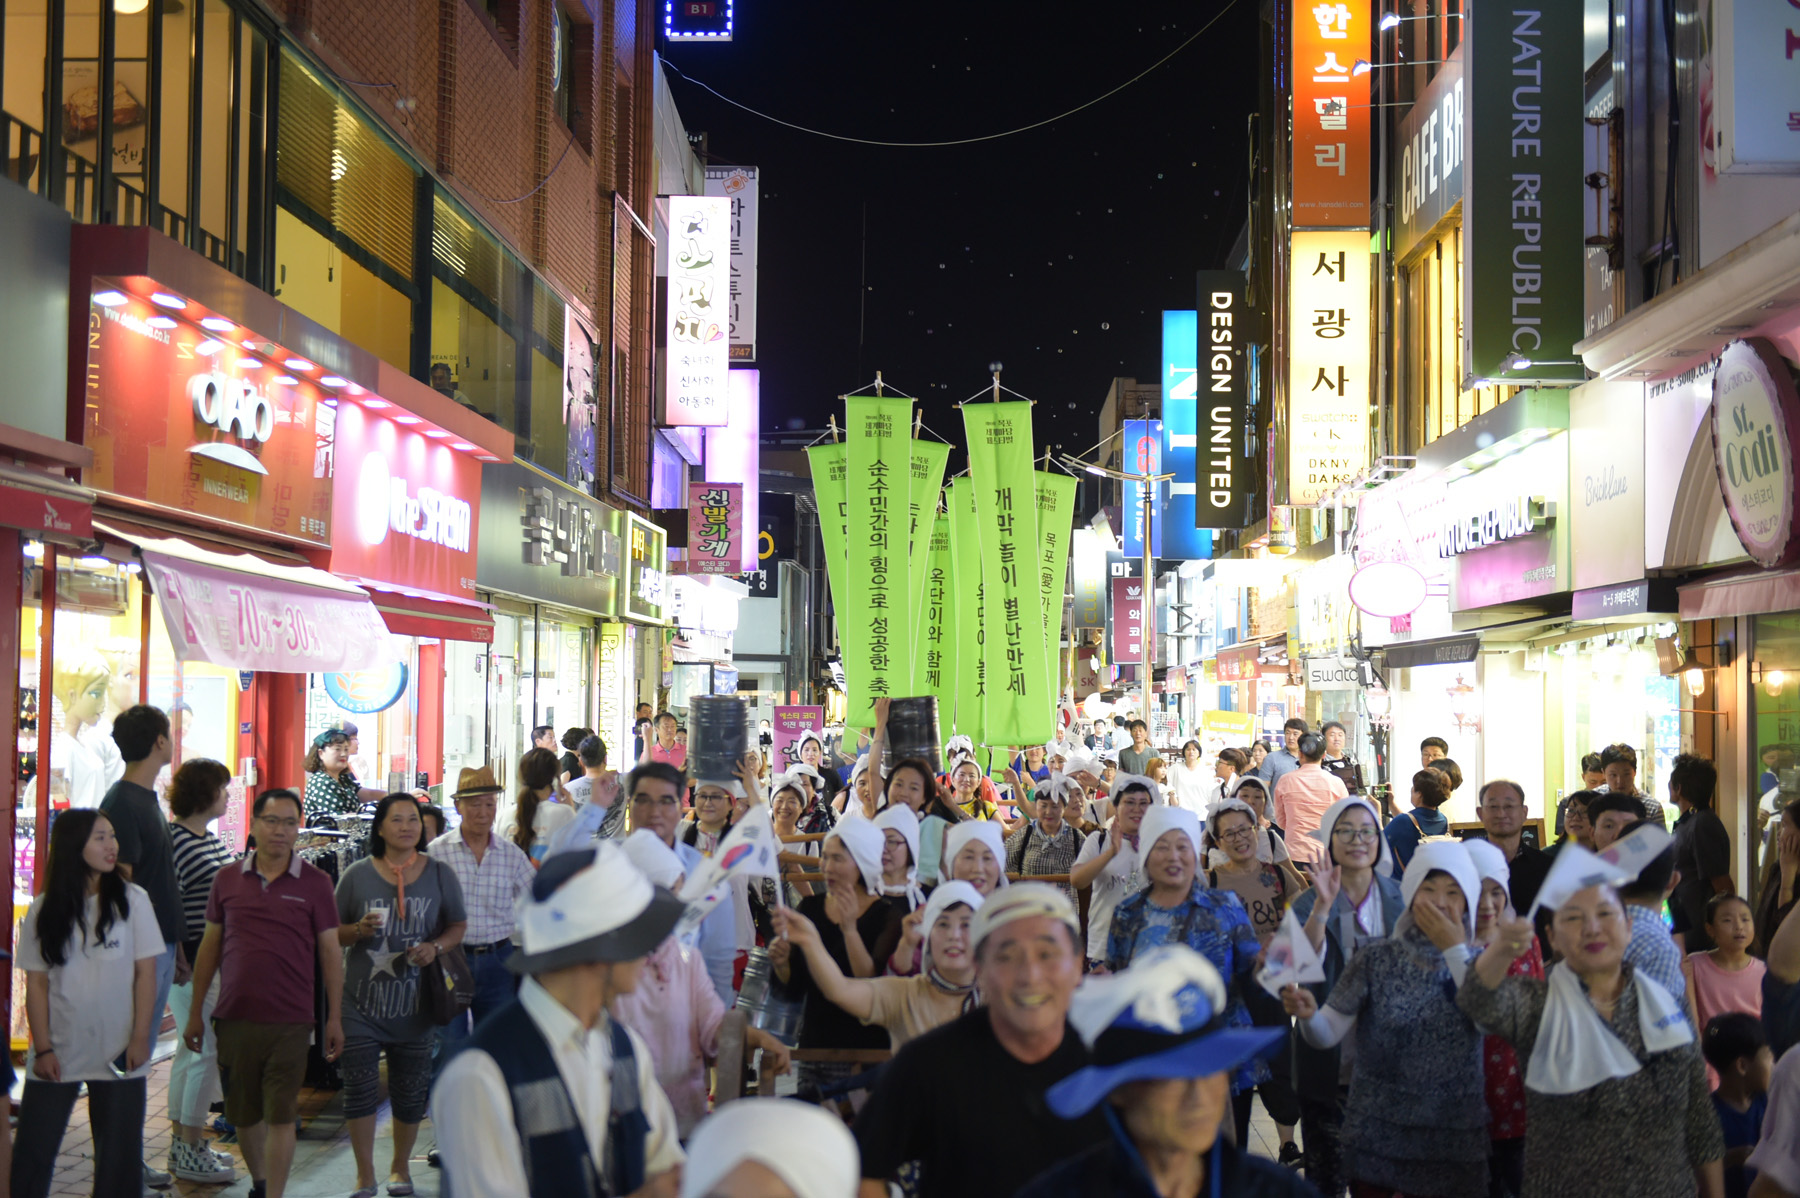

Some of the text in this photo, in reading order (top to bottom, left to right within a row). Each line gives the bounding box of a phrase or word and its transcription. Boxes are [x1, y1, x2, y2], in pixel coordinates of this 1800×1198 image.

[691, 5, 707, 14] B1
[1312, 4, 1351, 176] 한스델리
[1402, 109, 1438, 224] CAFE
[1512, 11, 1541, 351] NATURE REPUBLIC
[1312, 251, 1351, 396] 서광사
[679, 395, 715, 408] 아동화
[1211, 292, 1232, 508] DESIGN UNITED
[1732, 402, 1755, 438] St.
[1309, 458, 1349, 469] DKNY
[1725, 424, 1779, 489] Codi
[203, 483, 249, 504] INNERWEAR
[699, 489, 731, 557] 신발가게
[868, 459, 889, 550] 순수민간의
[868, 556, 888, 609] 힘으로
[995, 487, 1026, 696] 개막놀이 별난만세
[868, 617, 890, 671] 성공한
[925, 568, 945, 688] 옥단이와 함께
[1311, 667, 1359, 683] swatc
[802, 712, 816, 720] 코디
